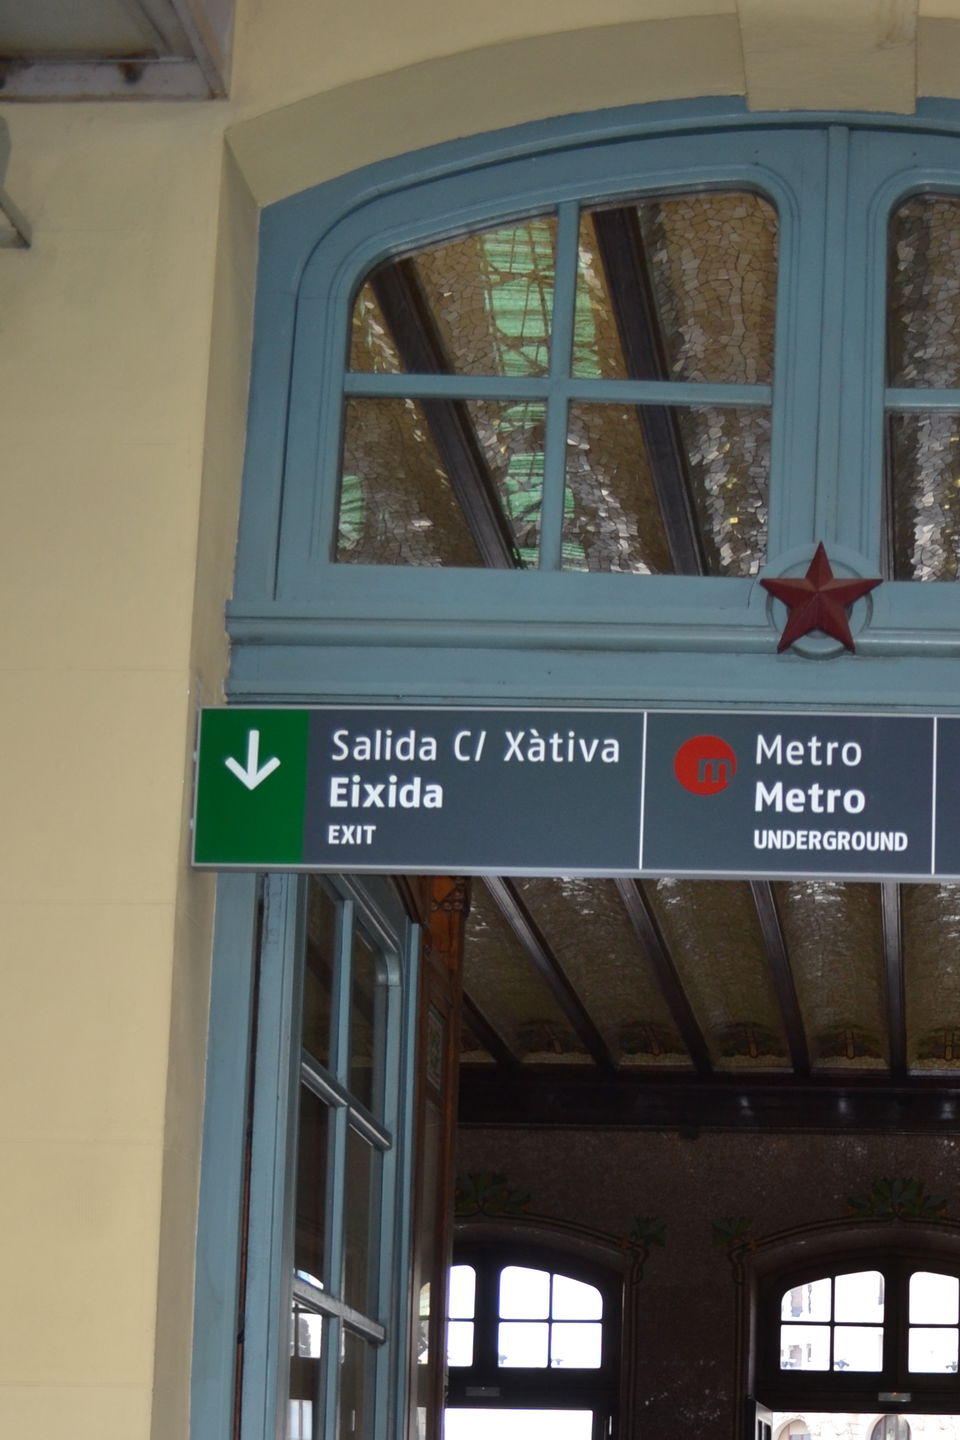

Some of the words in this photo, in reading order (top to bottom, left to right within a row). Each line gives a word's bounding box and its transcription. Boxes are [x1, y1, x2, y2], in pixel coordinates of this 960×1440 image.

[331, 729, 437, 762] Salida
[454, 730, 487, 762] C/
[504, 729, 620, 763] Xàtiva
[755, 733, 862, 766] Metro
[329, 774, 443, 809] Eixida
[754, 781, 866, 814] Metro
[327, 824, 376, 845] EXIT
[754, 829, 908, 852] UNDERGROUND
